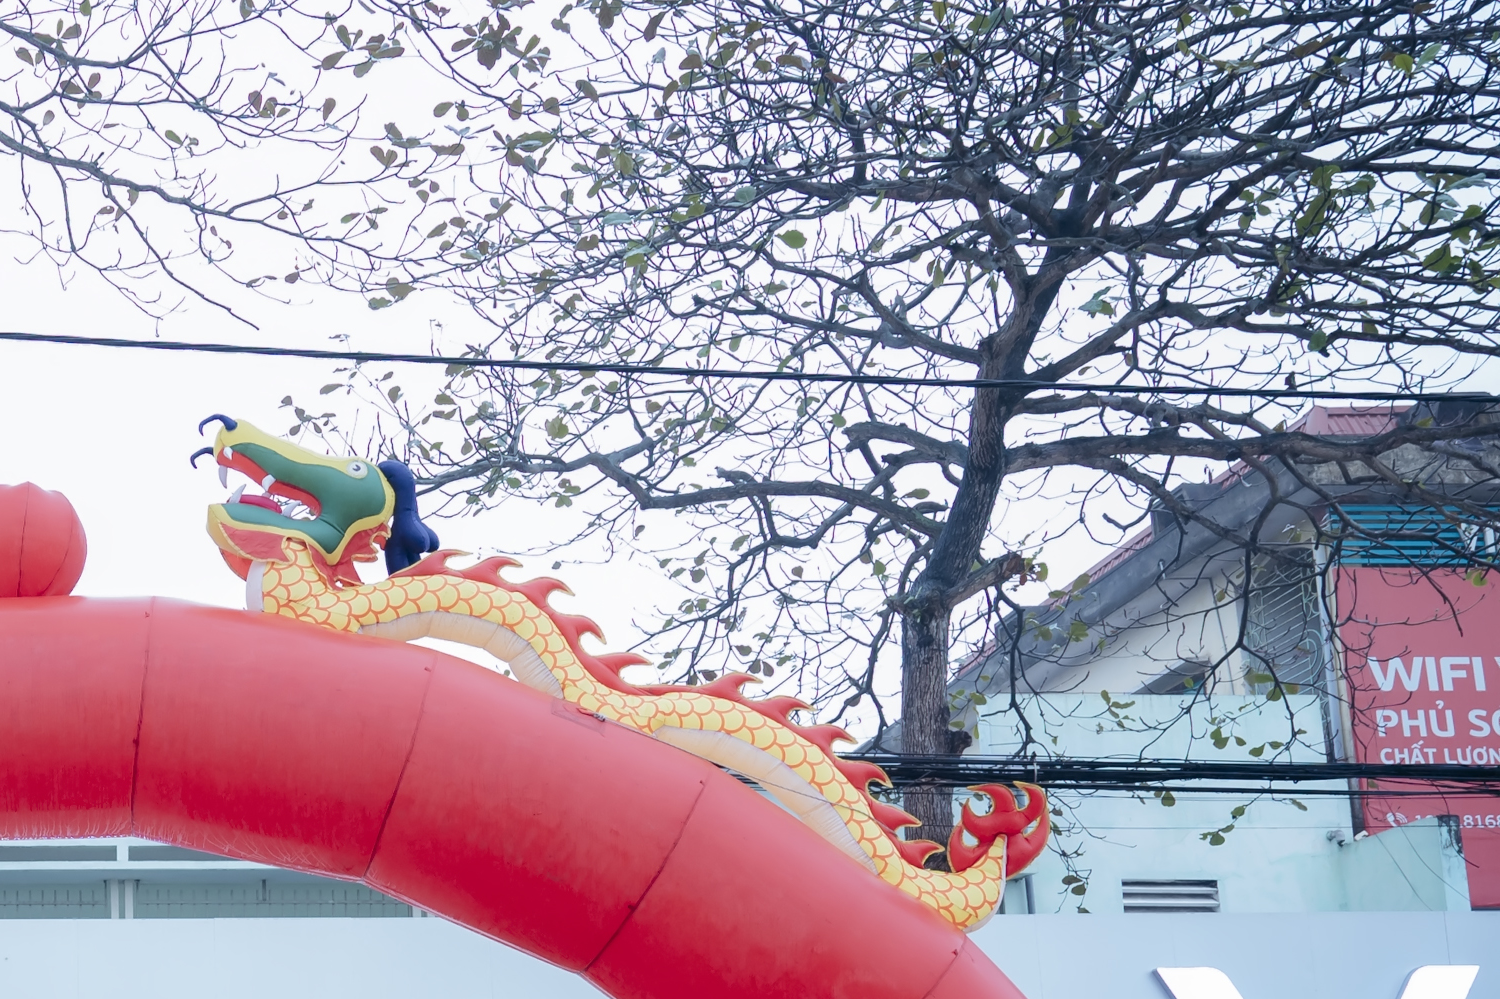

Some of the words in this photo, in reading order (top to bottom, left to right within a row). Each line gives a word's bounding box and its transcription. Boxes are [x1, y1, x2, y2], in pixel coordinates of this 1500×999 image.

[1367, 656, 1487, 692] WIFI
[1375, 699, 1456, 738] PHỦ
[1380, 739, 1437, 764] CHẤT
